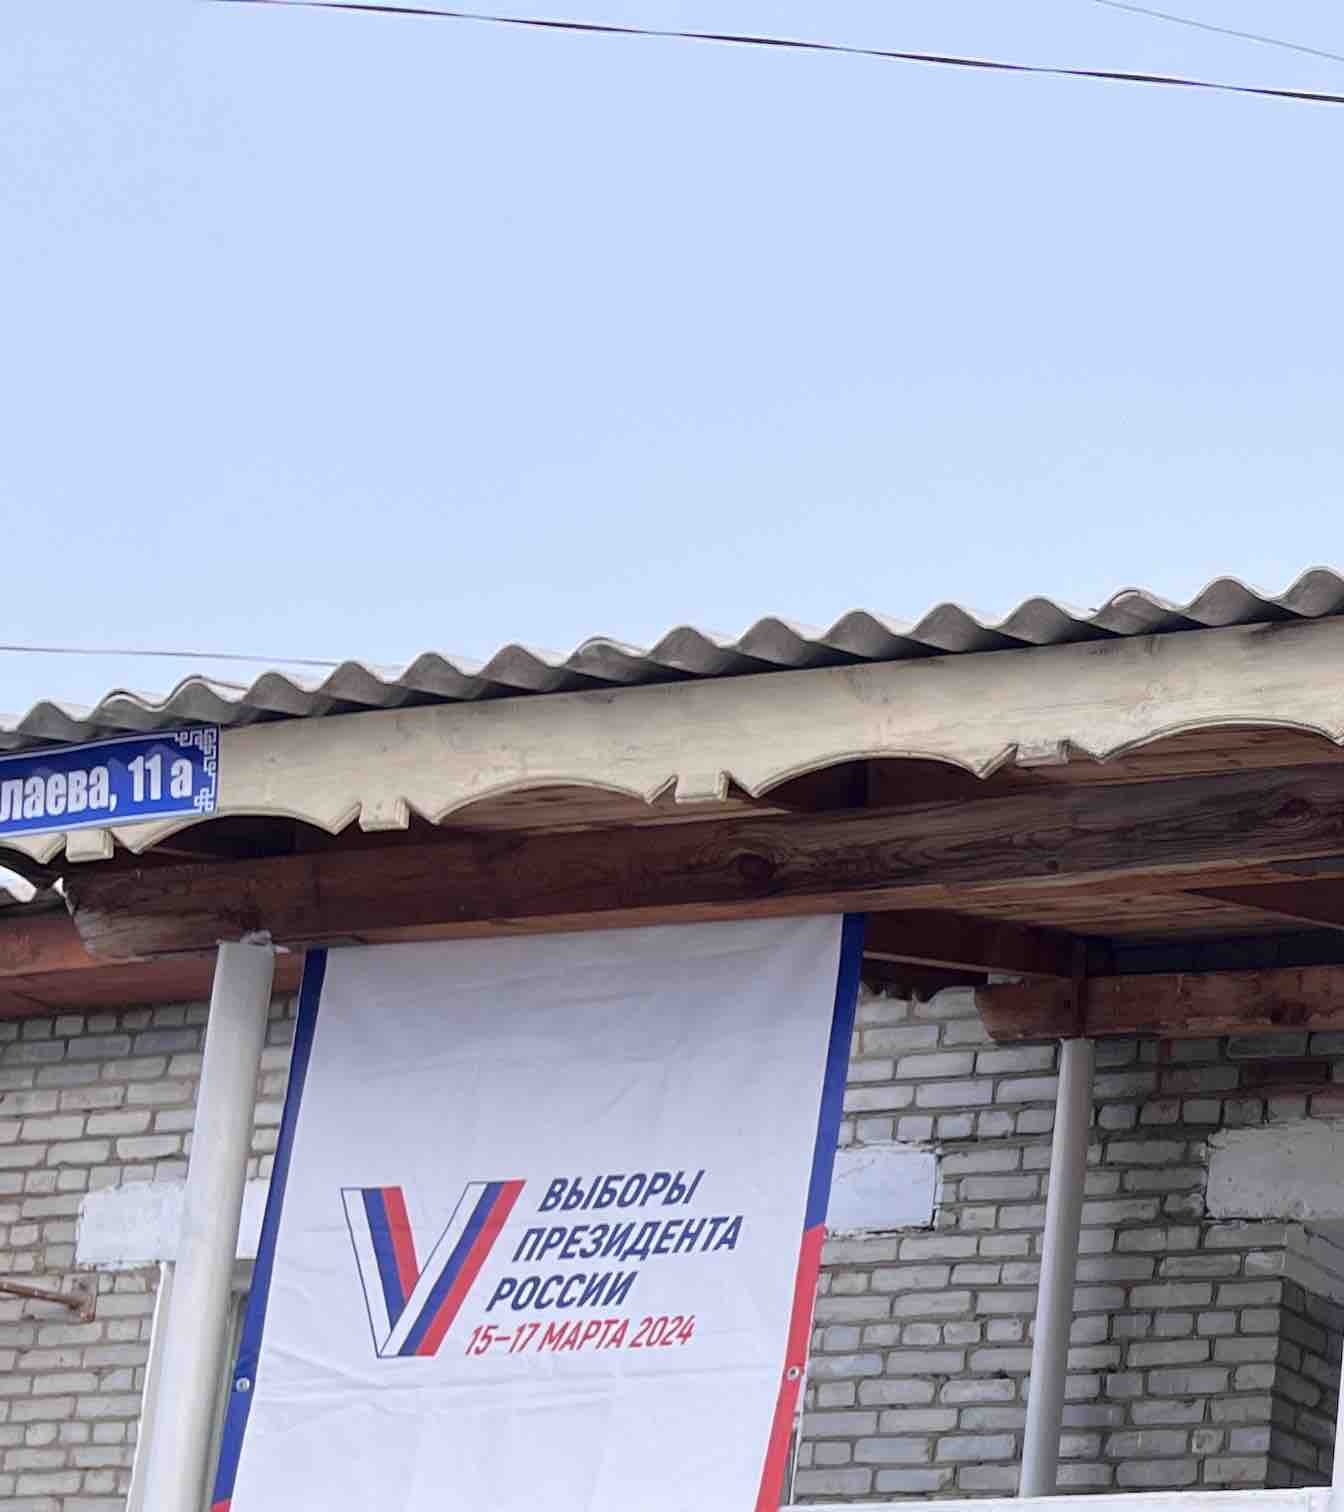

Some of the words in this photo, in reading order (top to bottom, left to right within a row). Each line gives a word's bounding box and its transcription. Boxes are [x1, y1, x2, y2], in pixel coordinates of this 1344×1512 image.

[128, 755, 162, 802] 11
[170, 759, 192, 798] а
[538, 1169, 705, 1212] ВЫБОРЫ
[512, 1215, 744, 1262] ПРЕЗИДЕНТА
[486, 1271, 638, 1312] РОССИИ
[537, 1318, 632, 1353] МАРТА
[629, 1314, 696, 1349] 2024
